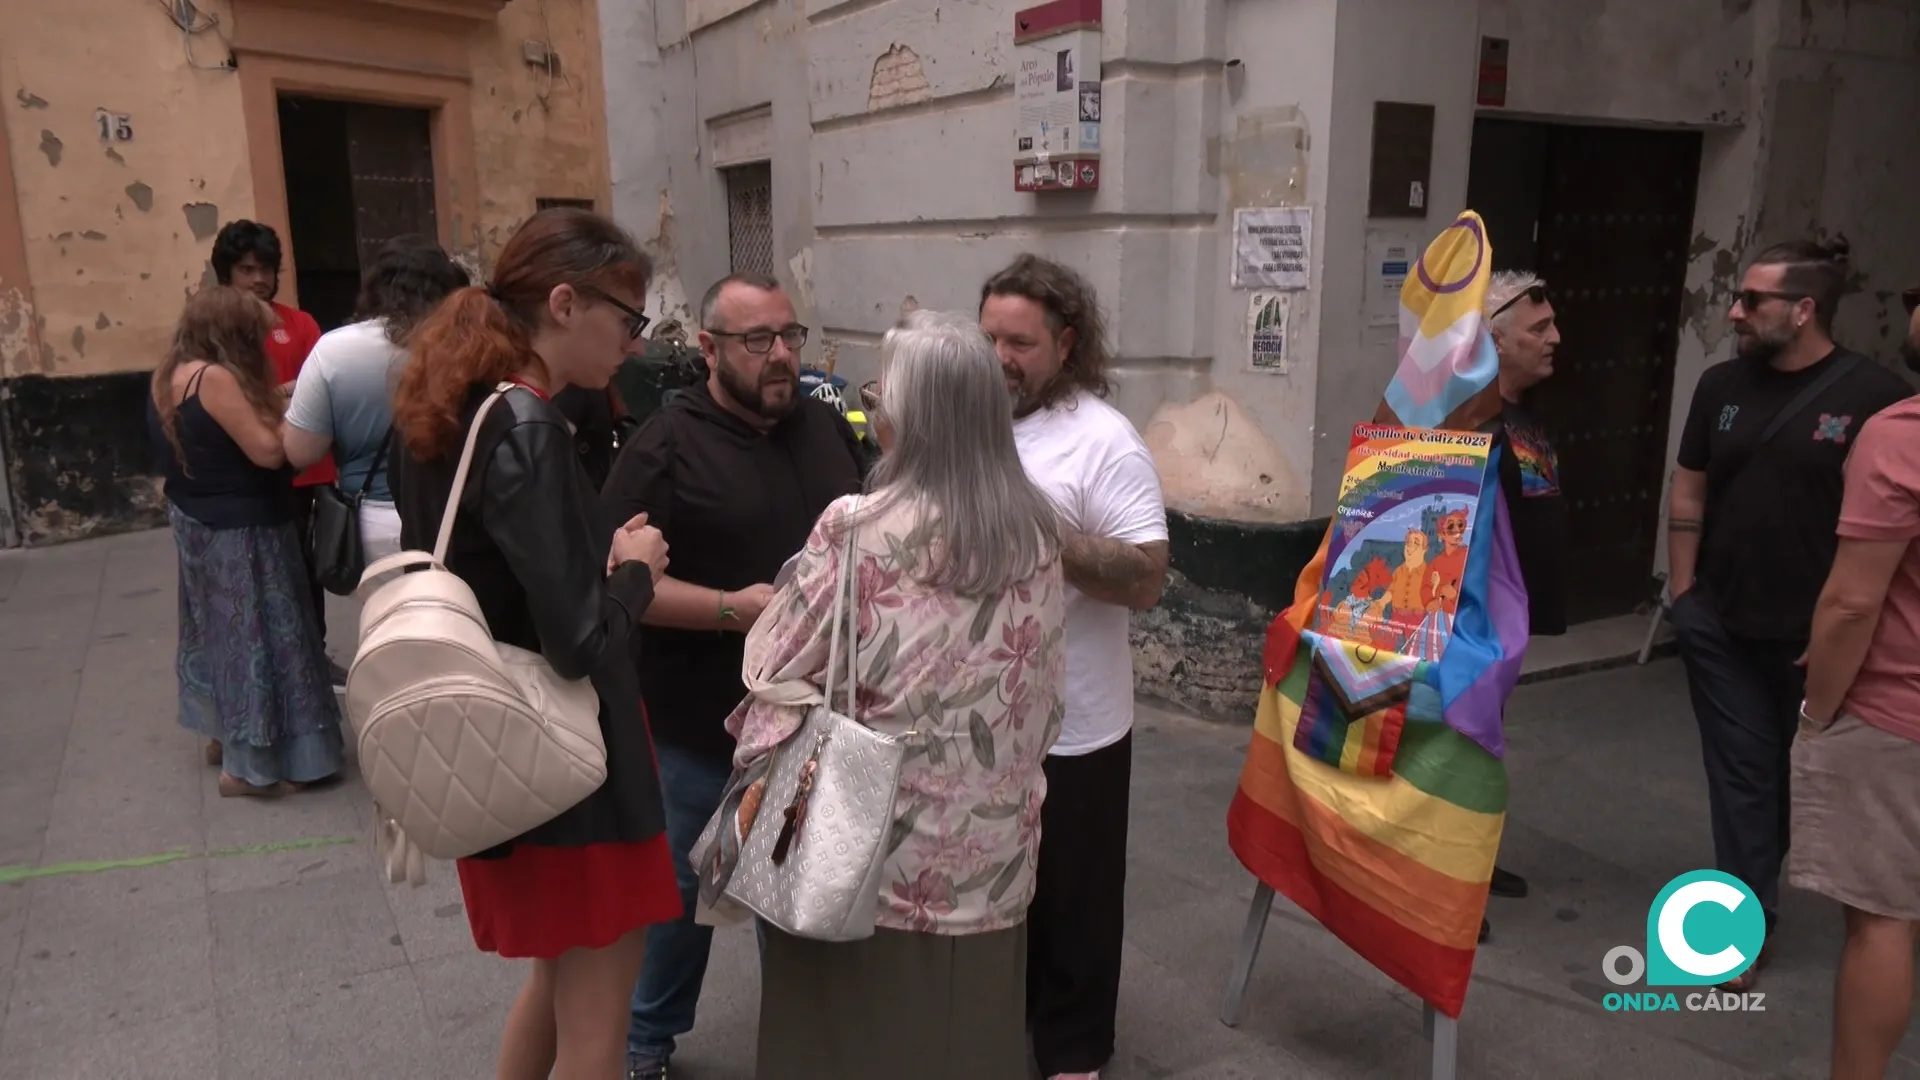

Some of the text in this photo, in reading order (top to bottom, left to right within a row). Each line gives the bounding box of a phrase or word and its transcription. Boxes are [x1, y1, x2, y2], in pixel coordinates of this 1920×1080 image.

[97, 113, 133, 141] 15
[1355, 426, 1487, 447] Orgullo de Cádiz 2025
[1356, 446, 1410, 459] Diversidad
